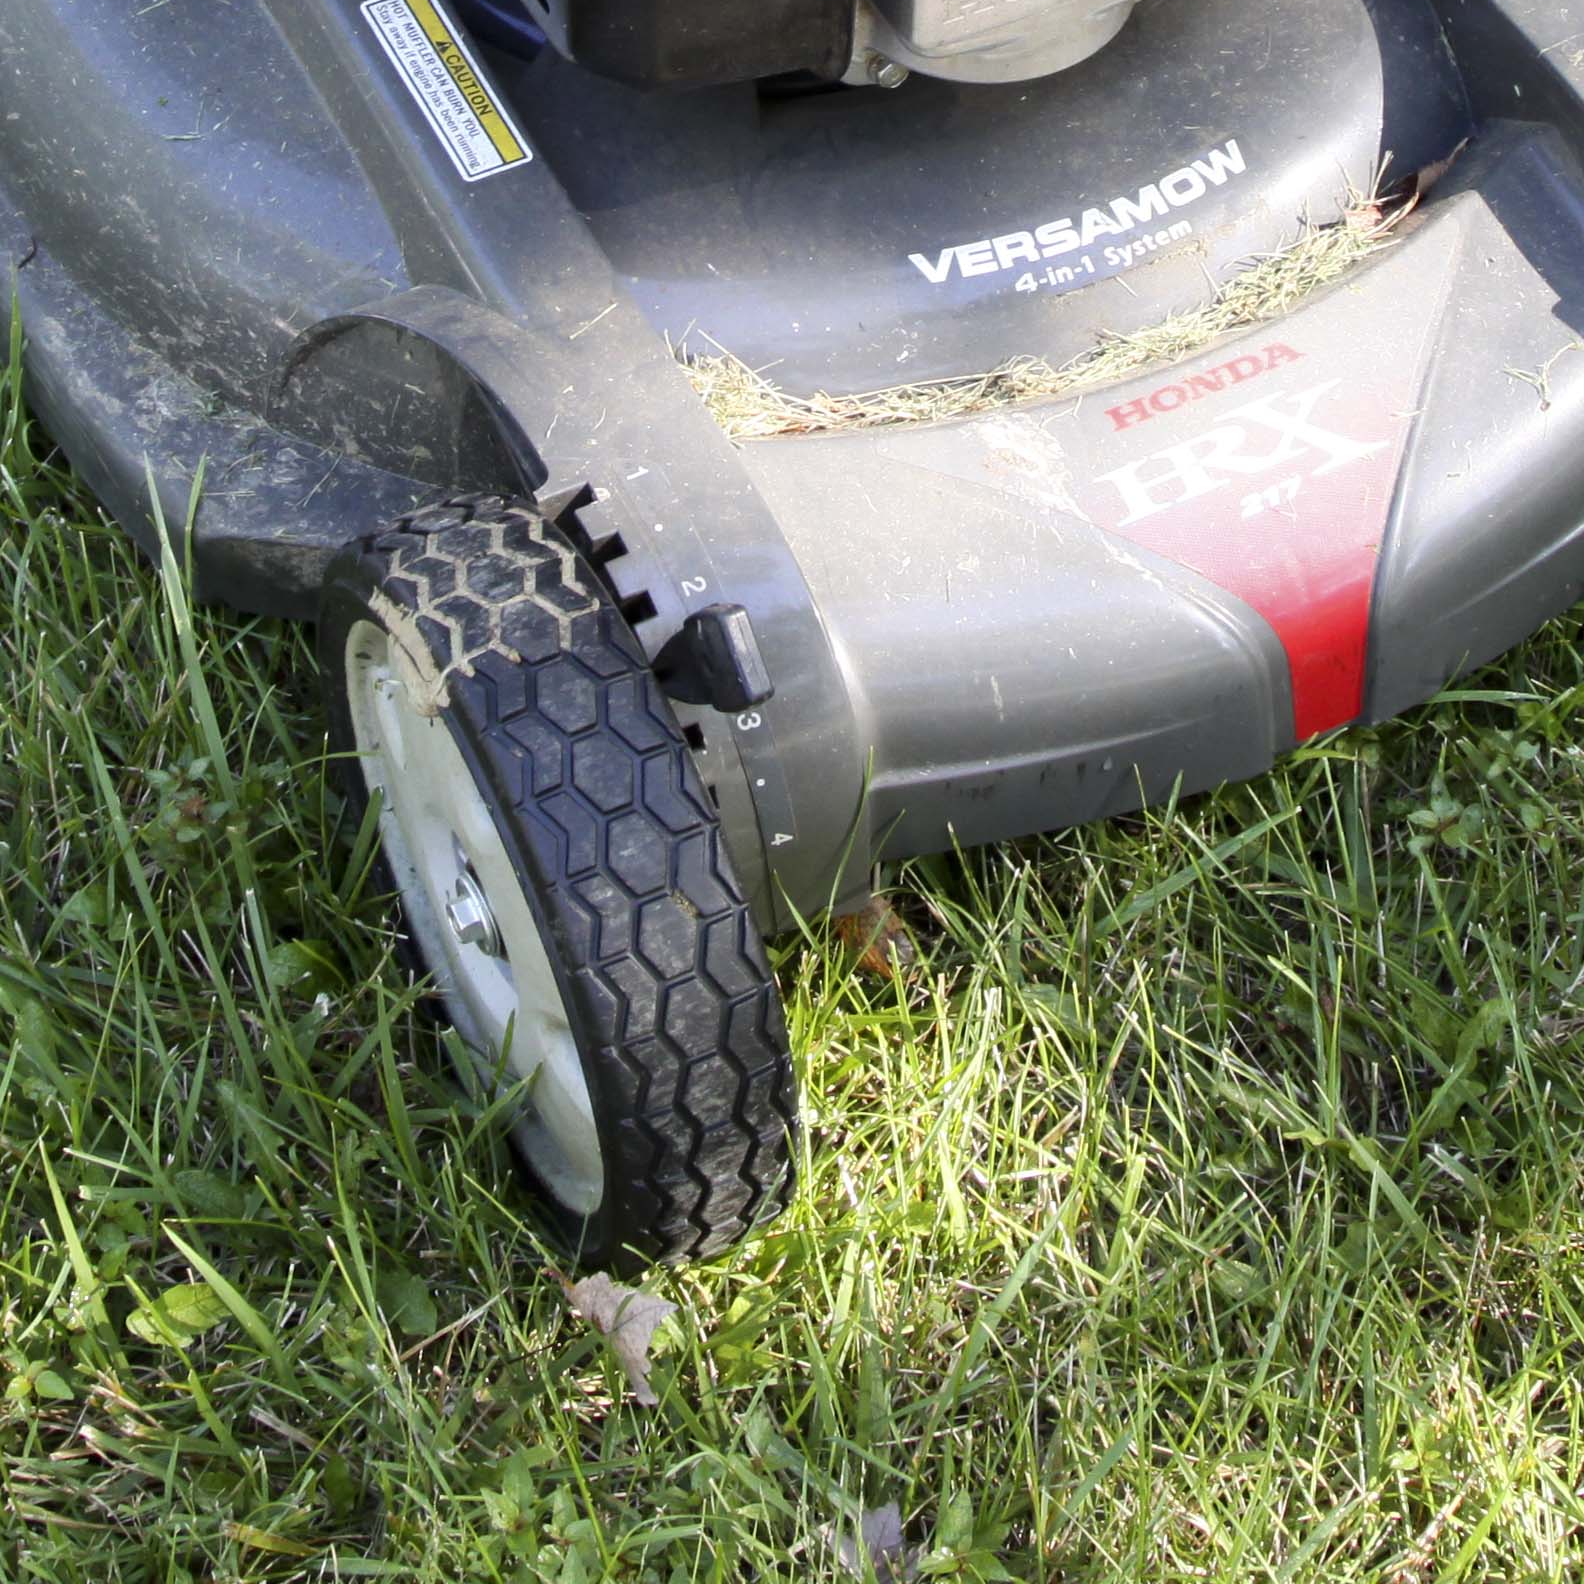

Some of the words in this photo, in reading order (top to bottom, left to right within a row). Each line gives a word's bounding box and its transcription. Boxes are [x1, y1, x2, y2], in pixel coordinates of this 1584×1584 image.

[376, 4, 393, 25] Stay
[389, 27, 409, 50] away
[409, 59, 433, 90] engine
[428, 90, 442, 108] has
[440, 108, 459, 133] been
[388, 0, 408, 19] HOT
[402, 22, 436, 66] MUFFLER
[430, 67, 449, 87] CAN
[443, 88, 468, 116] BURN
[445, 54, 493, 116] CAUTION
[908, 138, 1248, 284] VERSAMOW
[1014, 256, 1096, 295] 4-in-1
[1105, 219, 1193, 268] System
[1104, 342, 1307, 432] HONDA
[626, 465, 649, 482] 1
[1092, 378, 1391, 528] HRX
[681, 575, 707, 597] 2
[736, 712, 762, 732] 3
[770, 832, 794, 847] 4
